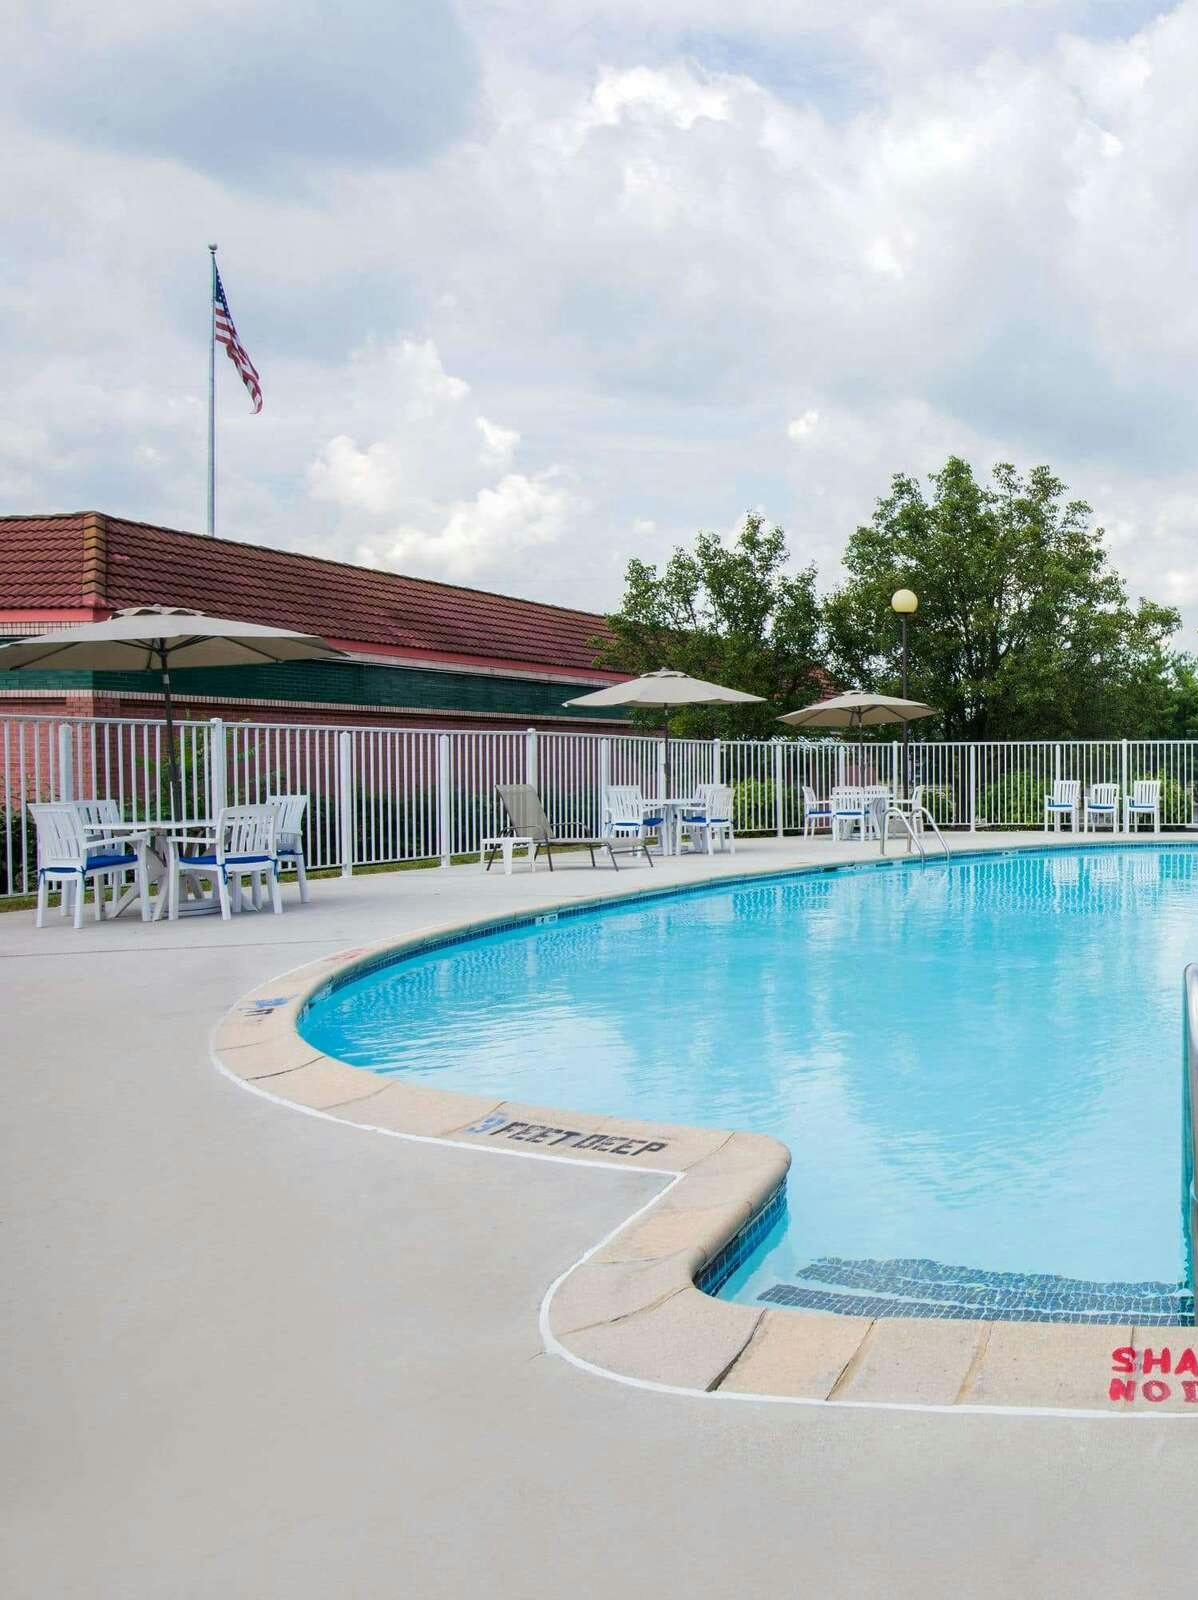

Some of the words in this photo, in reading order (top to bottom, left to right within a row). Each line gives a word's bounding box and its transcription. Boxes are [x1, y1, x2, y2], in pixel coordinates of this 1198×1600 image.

[489, 1121, 582, 1147] FEET
[570, 1134, 668, 1156] DEEP
[1108, 1377, 1171, 1403] NO
